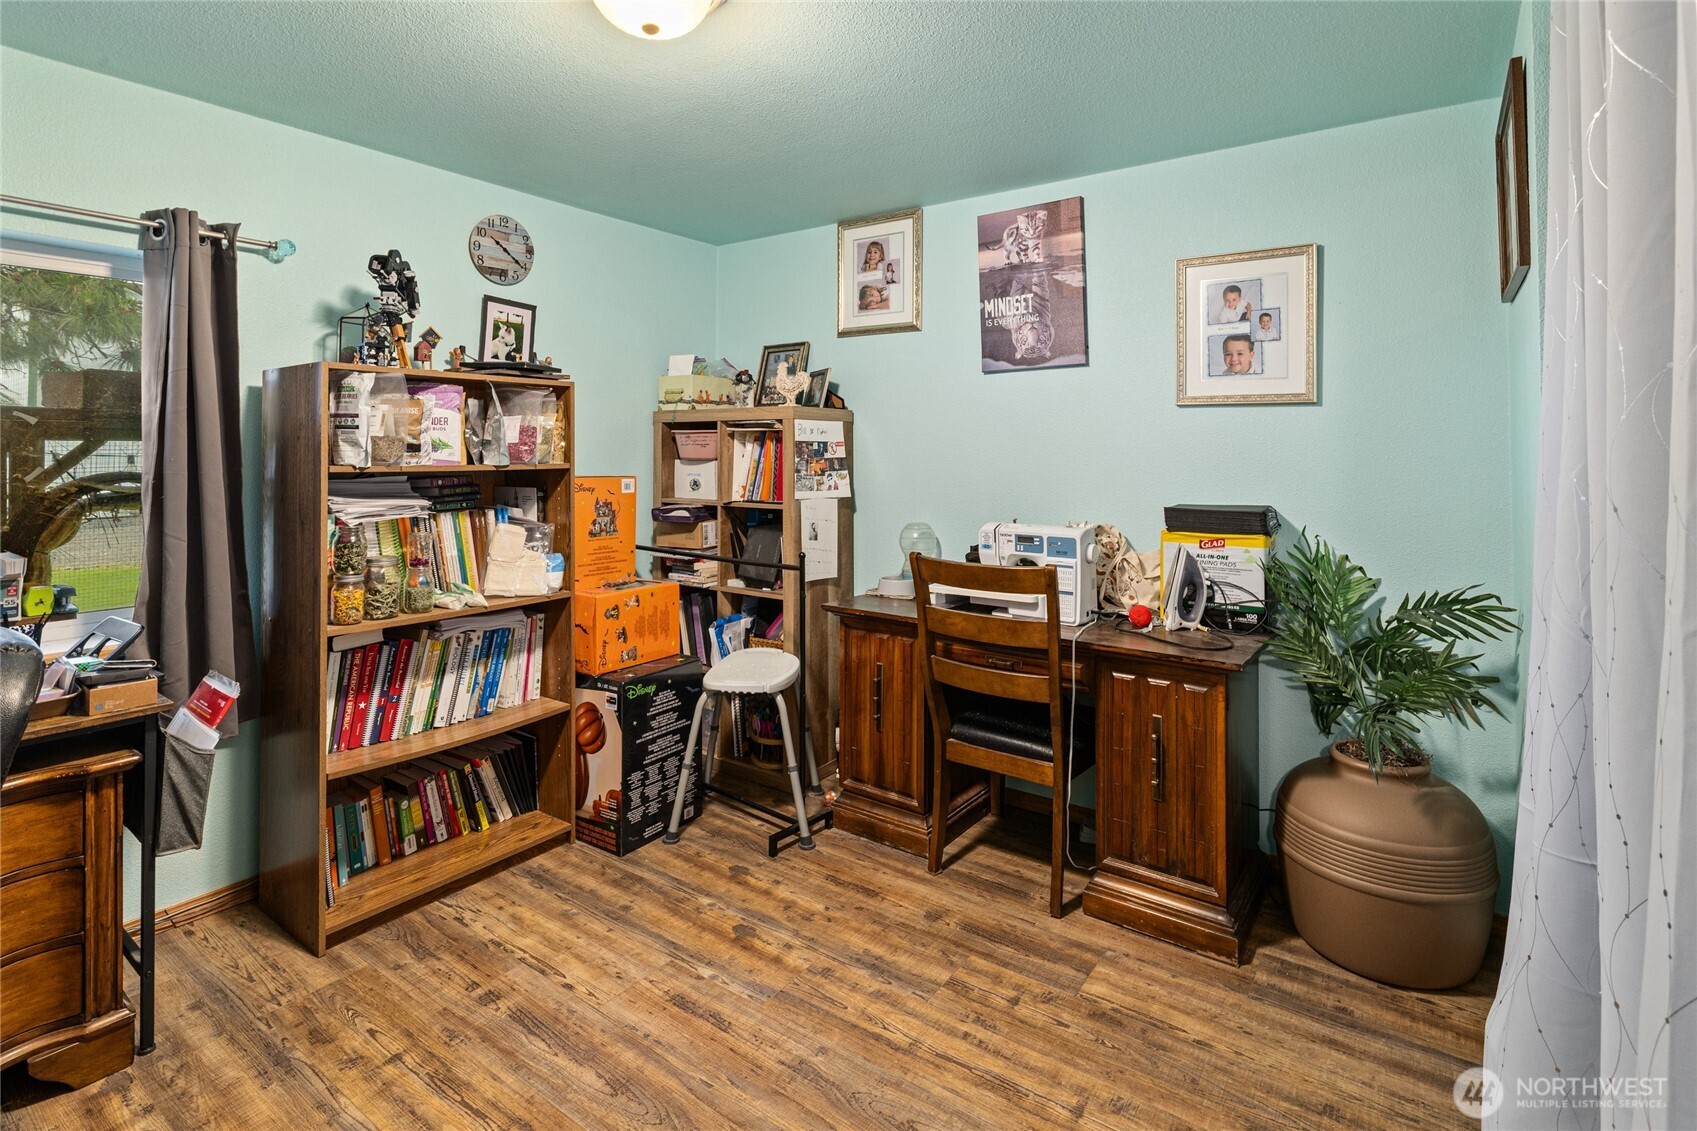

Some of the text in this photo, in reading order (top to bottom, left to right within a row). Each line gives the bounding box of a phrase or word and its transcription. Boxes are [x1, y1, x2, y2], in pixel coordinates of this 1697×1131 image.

[487, 218, 495, 228] 11
[499, 217, 509, 228] 12
[514, 223, 518, 232] 1
[476, 226, 487, 238] 10
[473, 240, 481, 251] 9
[522, 235, 530, 246] 2
[476, 254, 485, 265] 8
[525, 249, 533, 260] 3
[487, 266, 495, 277] 7
[522, 262, 528, 272] 4
[499, 270, 507, 282] 6
[511, 270, 519, 281] 5
[984, 293, 1034, 318] MINDSET
[985, 319, 993, 327] IS
[1201, 539, 1225, 548] GLAD
[1195, 553, 1229, 561] ALL-IN-ONE
[597, 639, 609, 670] Disney
[449, 646, 460, 675] BIOLOGY
[342, 653, 361, 731] THE AMERICAN REPUBLIC
[624, 683, 657, 700] Disney
[391, 695, 398, 703] 2
